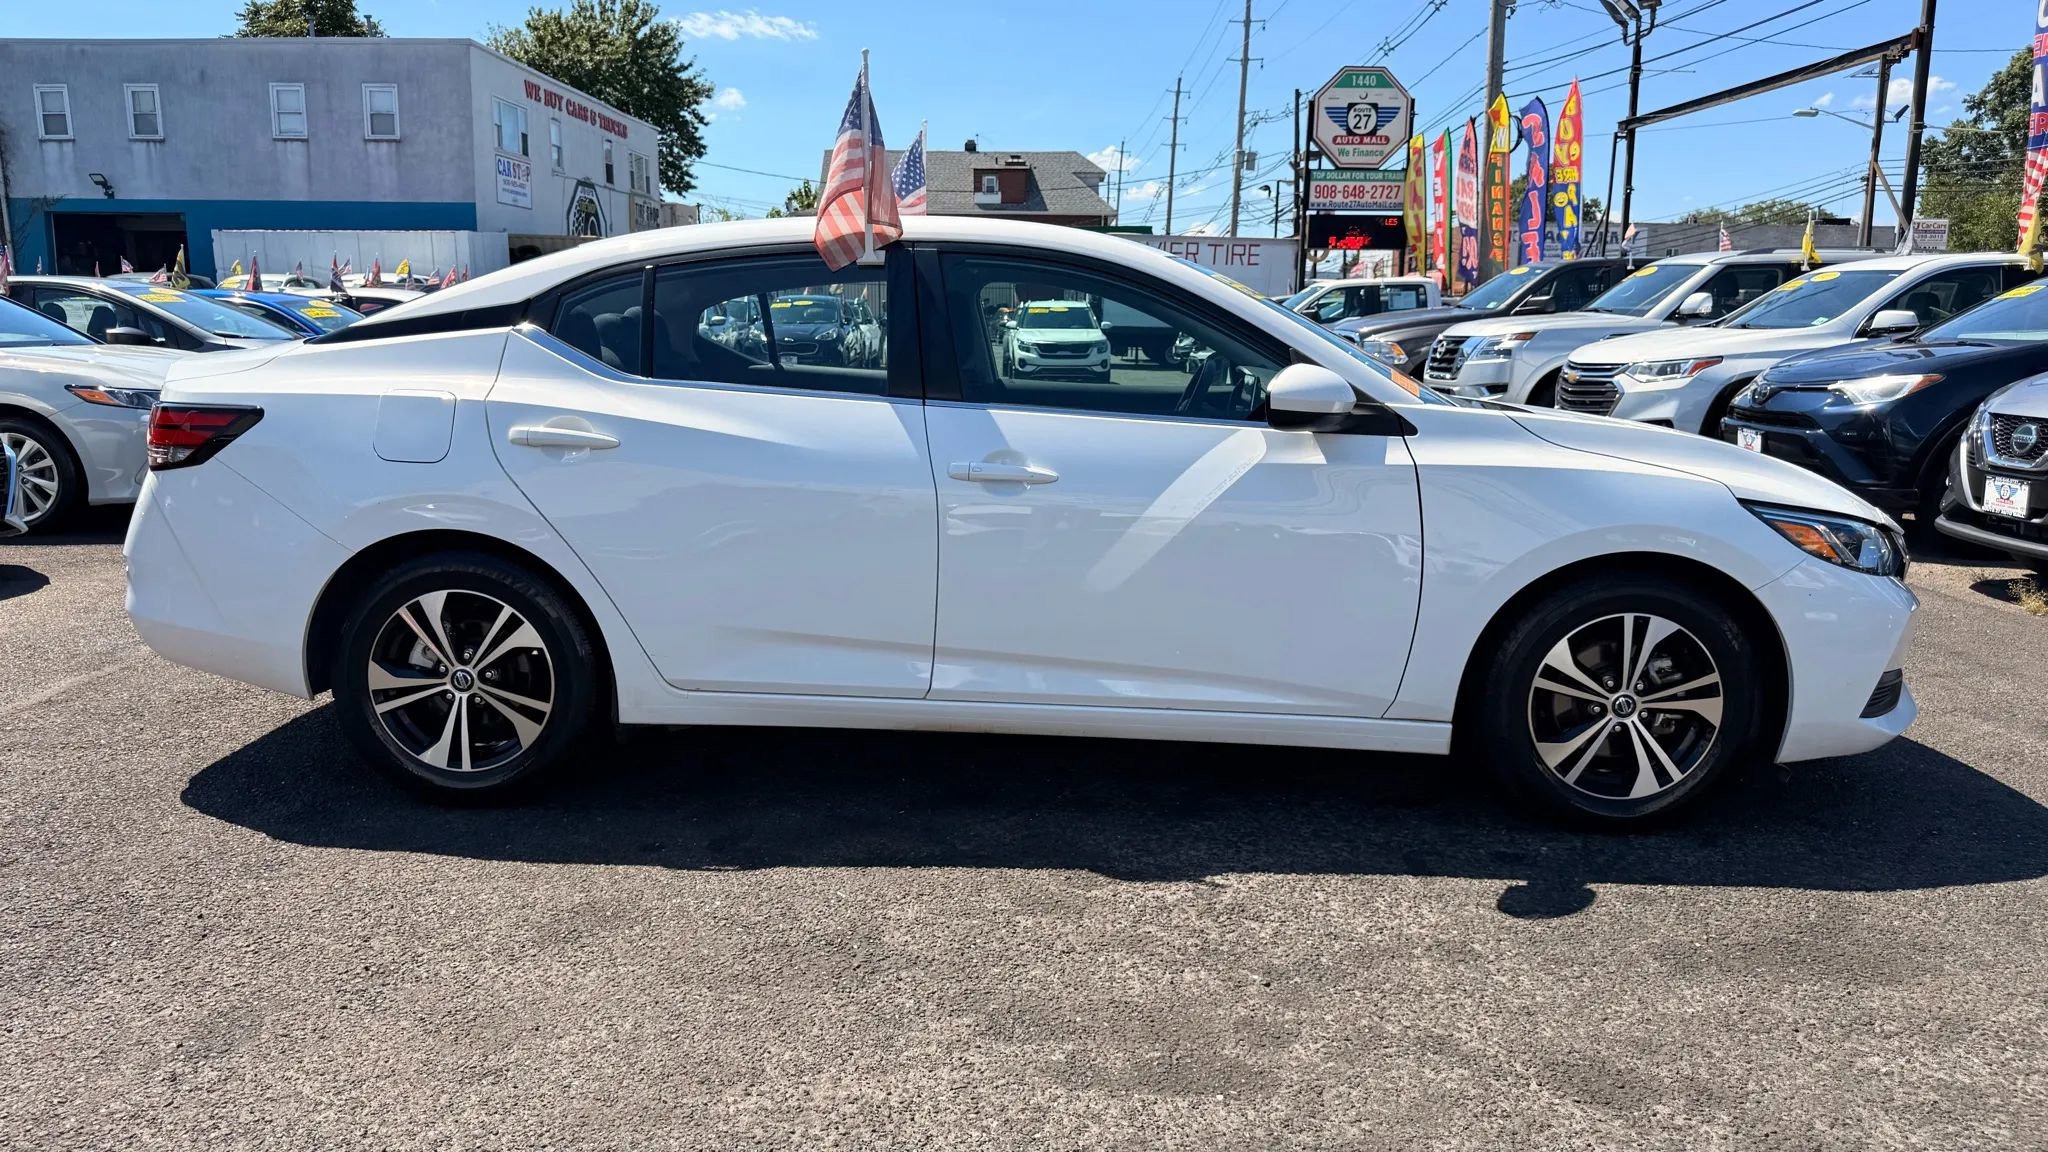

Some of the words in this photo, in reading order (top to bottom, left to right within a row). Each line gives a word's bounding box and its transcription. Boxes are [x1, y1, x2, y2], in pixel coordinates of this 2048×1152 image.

[1352, 75, 1376, 86] 1440
[524, 80, 541, 103] WE
[544, 89, 563, 112] BUY
[565, 98, 589, 123] CARS
[598, 112, 628, 139] TRUCKS
[1353, 114, 1371, 130] 27
[1335, 136, 1360, 144] AUTO
[1362, 136, 1386, 144] MALL
[1337, 147, 1350, 157] We
[1352, 147, 1384, 157] Finance
[497, 158, 512, 178] CAR
[1314, 184, 1400, 199] 908-648-2727
[1207, 243, 1261, 266] TIRE
